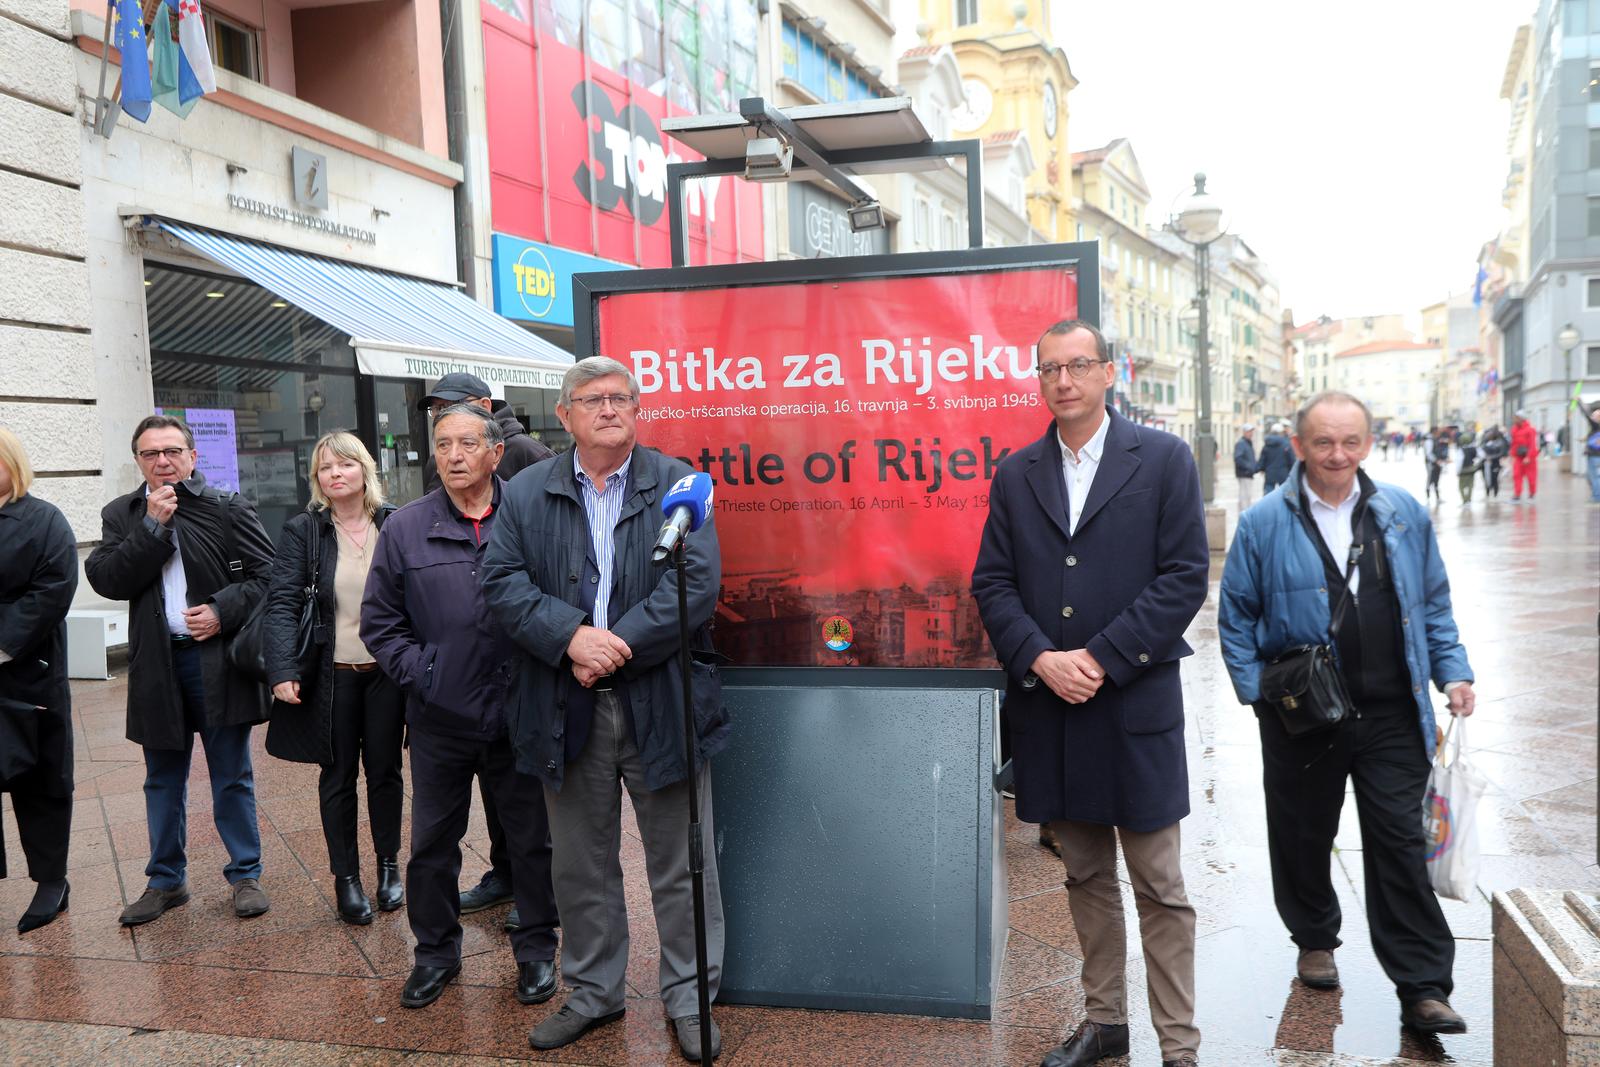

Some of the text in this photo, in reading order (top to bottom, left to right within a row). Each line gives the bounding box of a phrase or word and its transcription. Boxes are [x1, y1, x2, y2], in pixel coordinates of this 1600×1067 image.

[227, 193, 376, 246] TOURIST INFORMATION
[513, 263, 556, 299] TEDi
[474, 365, 541, 385] INFORMATIVNI
[630, 334, 1039, 395] Bitka za Rijeku
[760, 399, 830, 418] operacija,
[834, 400, 853, 414] 16.
[857, 398, 908, 414] travnja
[927, 396, 940, 410] 3.
[944, 395, 997, 411] svibnja
[1001, 393, 1041, 407] 1945.
[675, 443, 785, 486] ttle
[803, 439, 857, 485] of
[769, 498, 845, 514] Operation,
[849, 496, 866, 510] 16
[870, 496, 904, 513] April
[923, 495, 932, 508] 3
